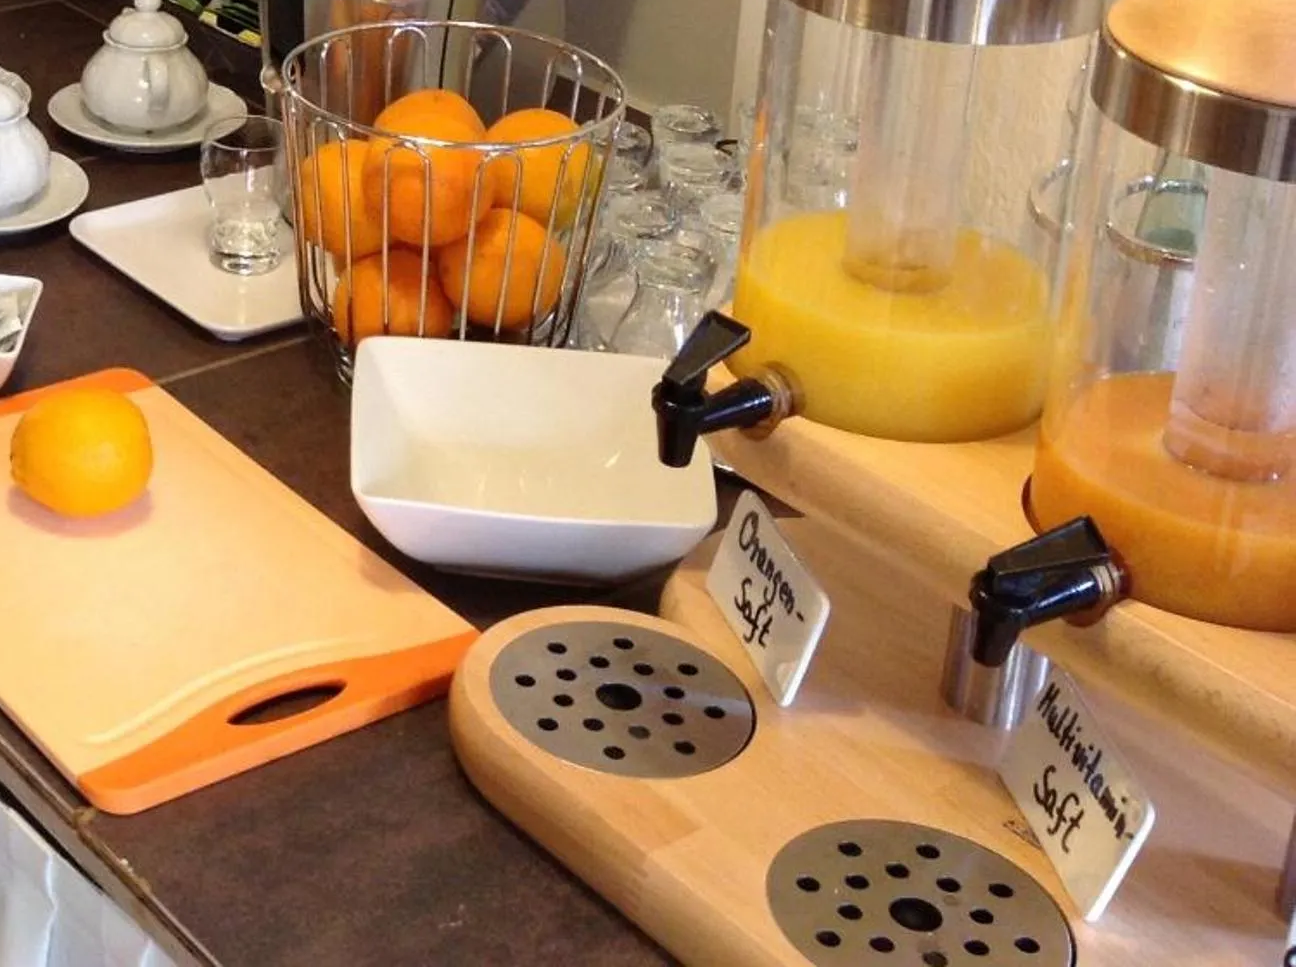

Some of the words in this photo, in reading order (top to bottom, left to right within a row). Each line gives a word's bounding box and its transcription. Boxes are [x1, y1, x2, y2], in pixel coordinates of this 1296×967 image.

[738, 509, 805, 623] Orangen-
[733, 577, 774, 649] Saft
[1033, 764, 1085, 854] Saft
